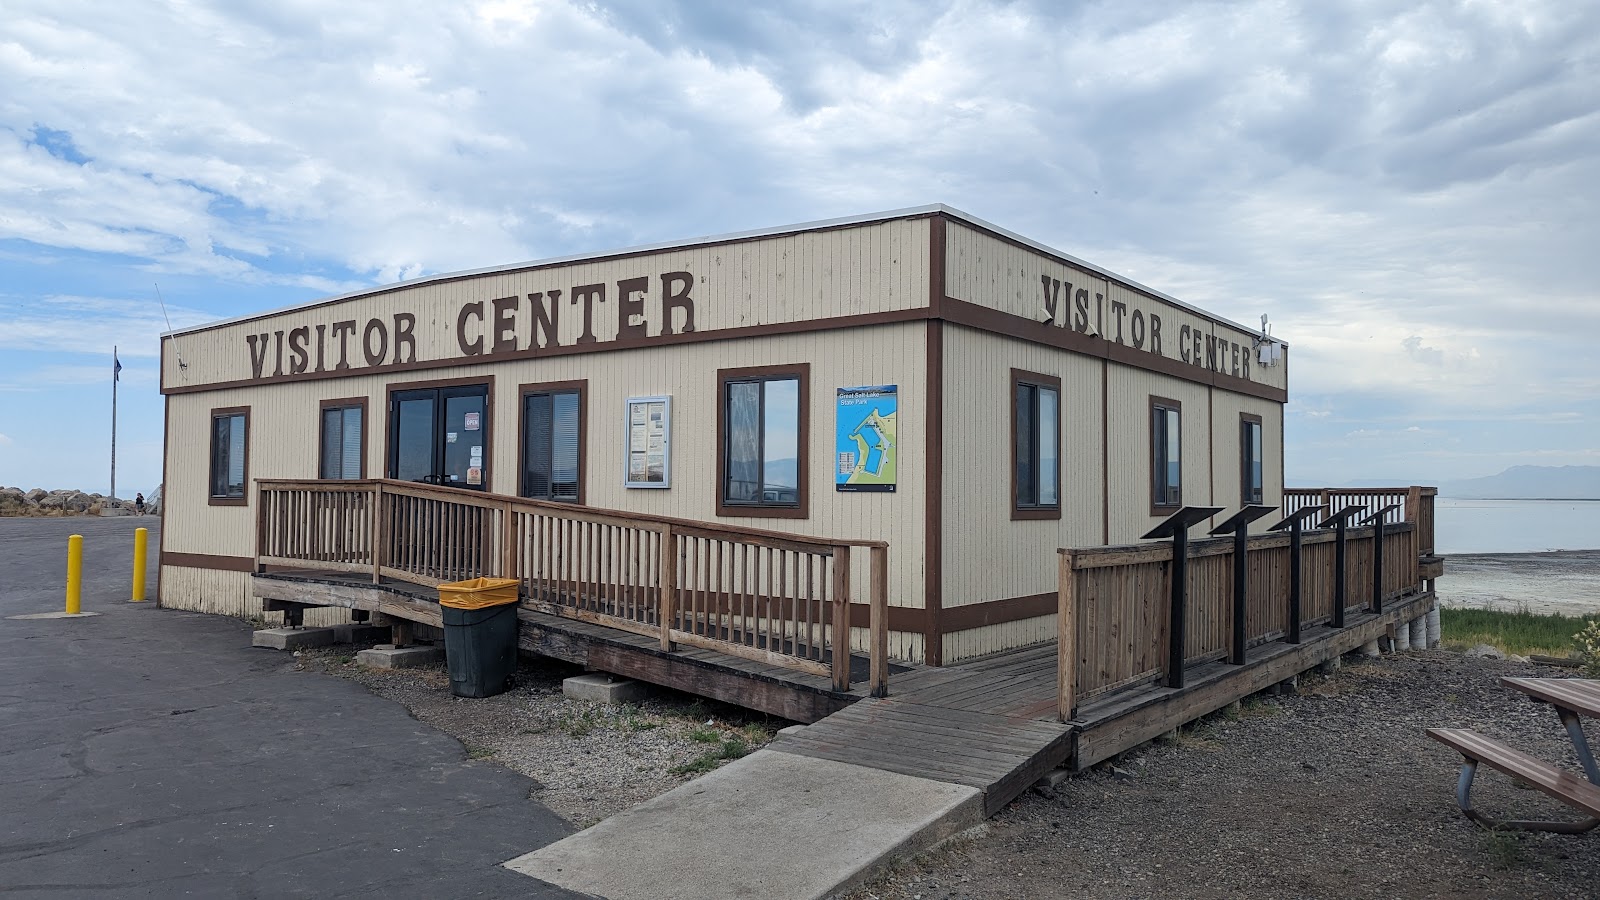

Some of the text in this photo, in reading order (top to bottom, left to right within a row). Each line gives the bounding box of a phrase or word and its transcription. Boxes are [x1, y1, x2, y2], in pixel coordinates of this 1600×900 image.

[246, 271, 695, 379] VISITOR CENTER
[1041, 275, 1251, 380] VISITOR CENTER
